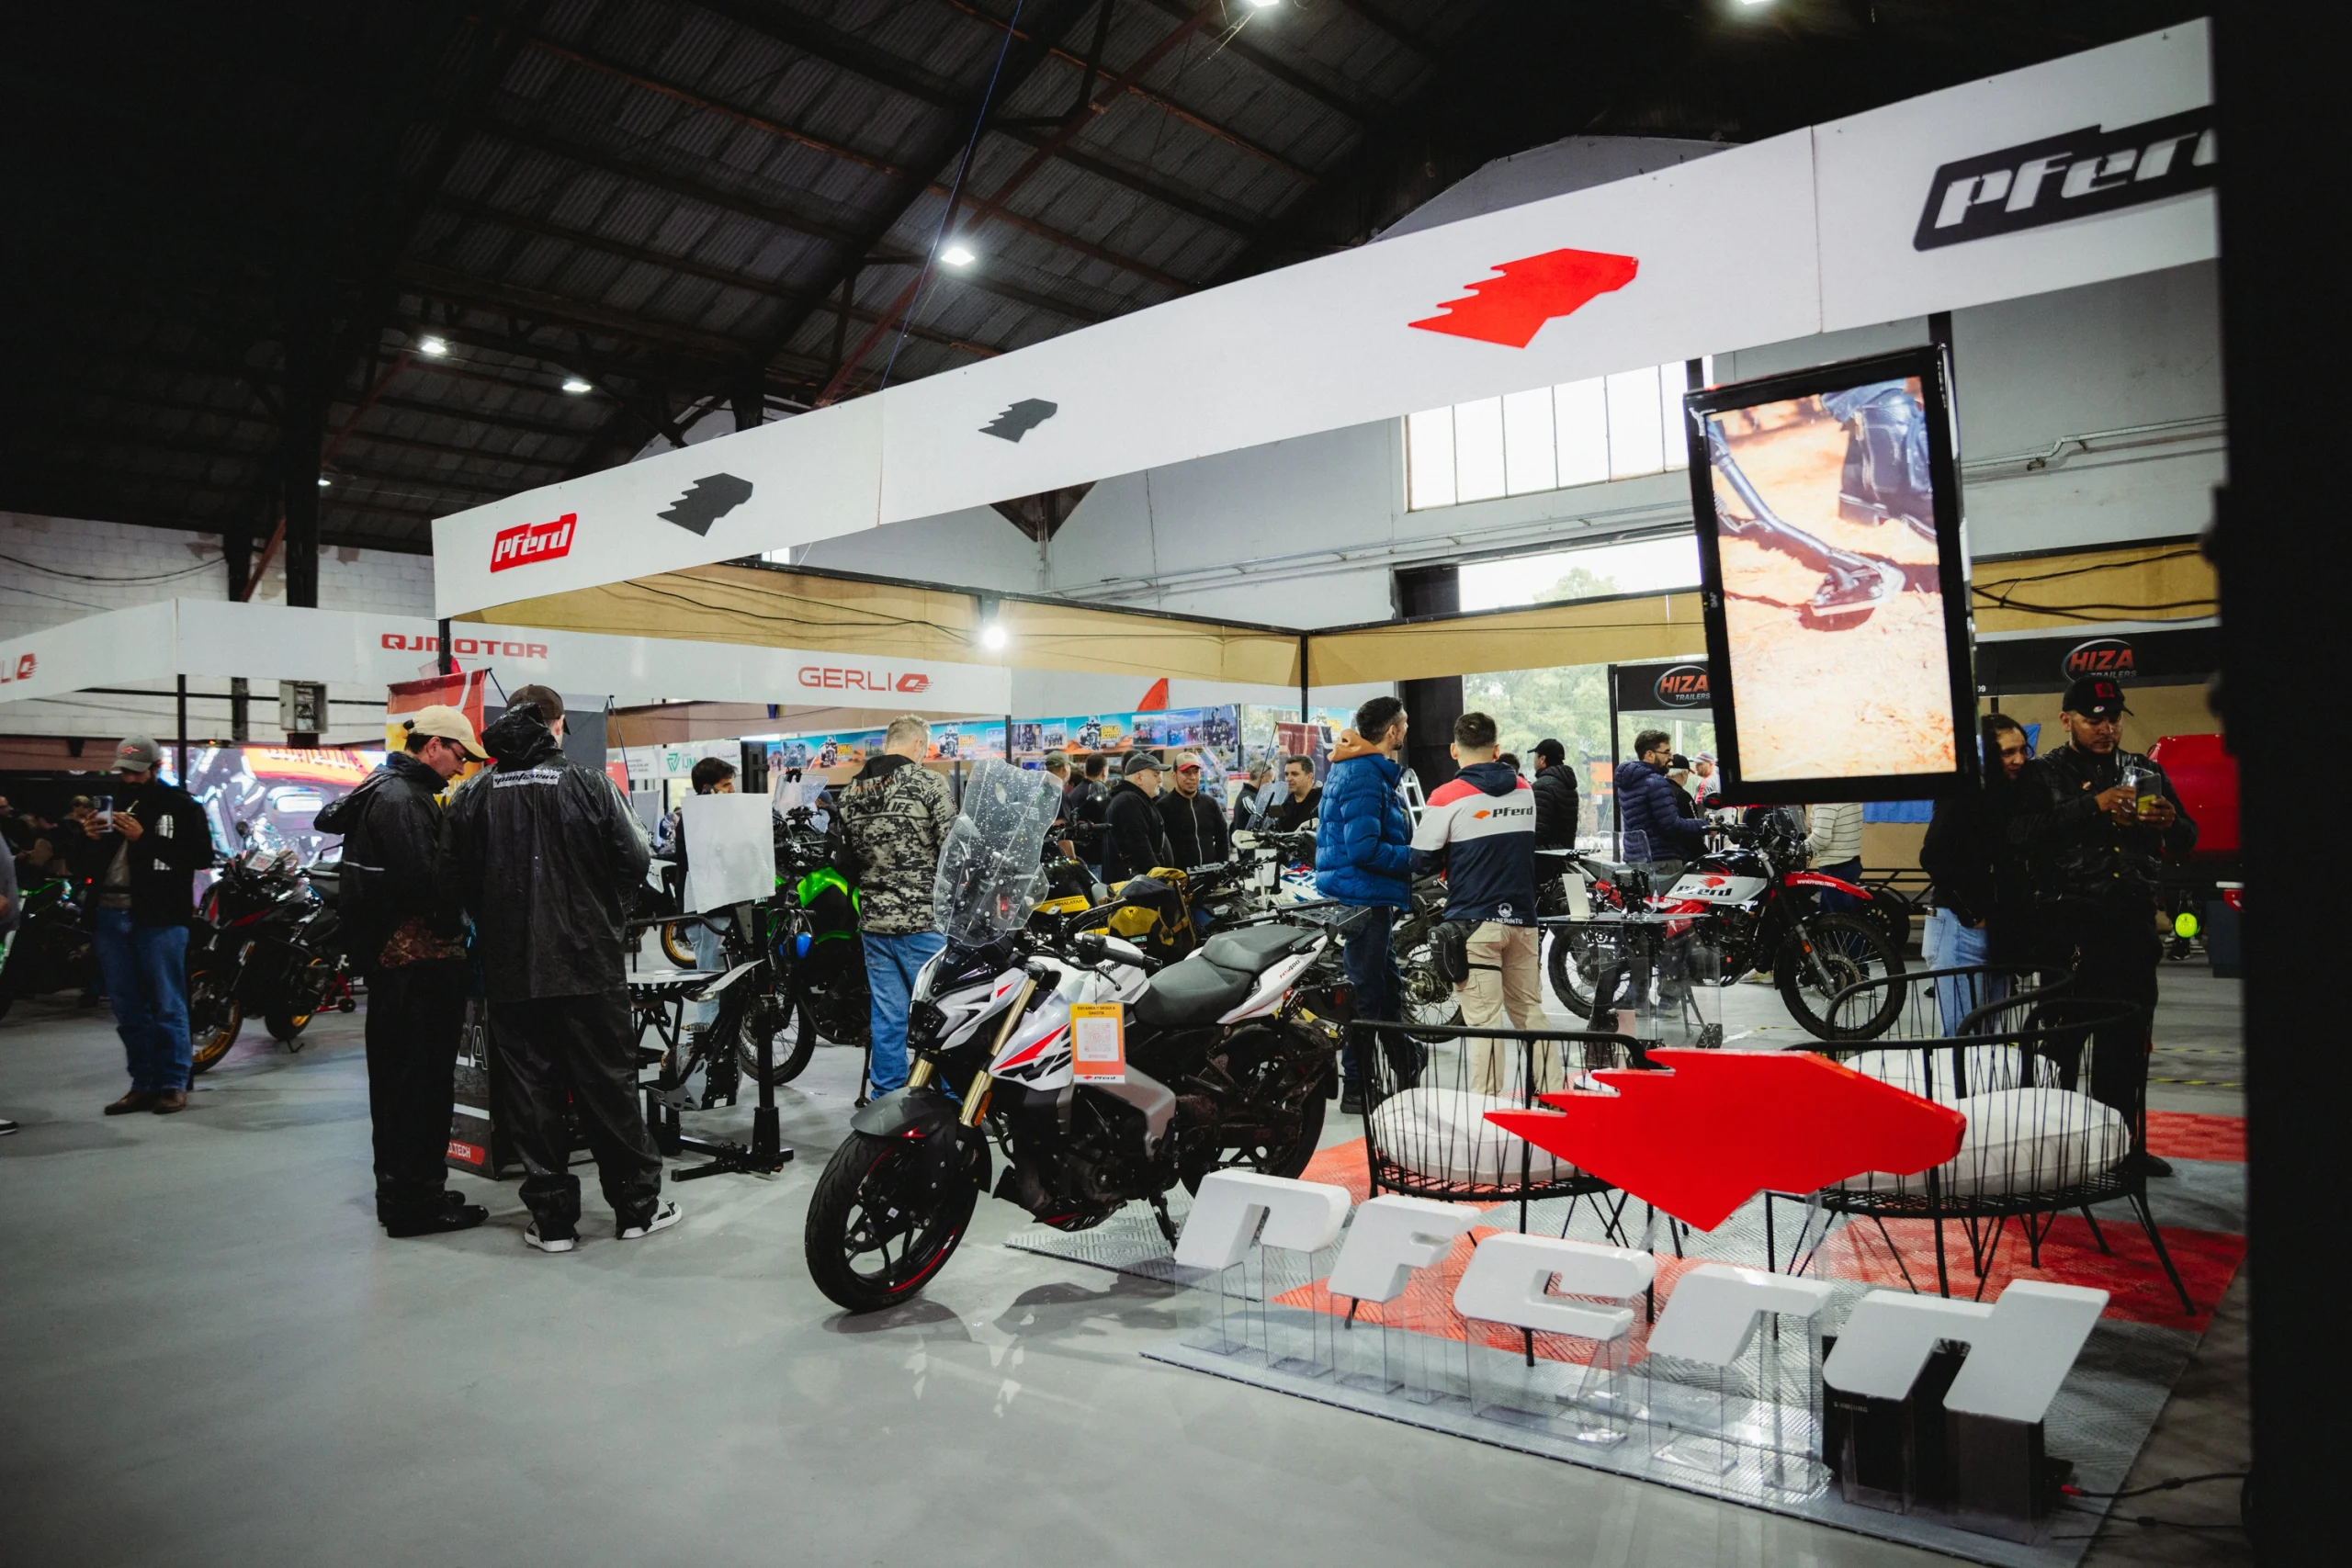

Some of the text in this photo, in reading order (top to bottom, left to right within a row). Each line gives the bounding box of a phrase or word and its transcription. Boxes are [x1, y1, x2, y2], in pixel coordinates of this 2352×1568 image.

[494, 523, 571, 563] pferd
[2069, 648, 2134, 671] HIZA
[1659, 674, 1709, 694] HIZA
[1675, 693, 1711, 701] TRAILERS
